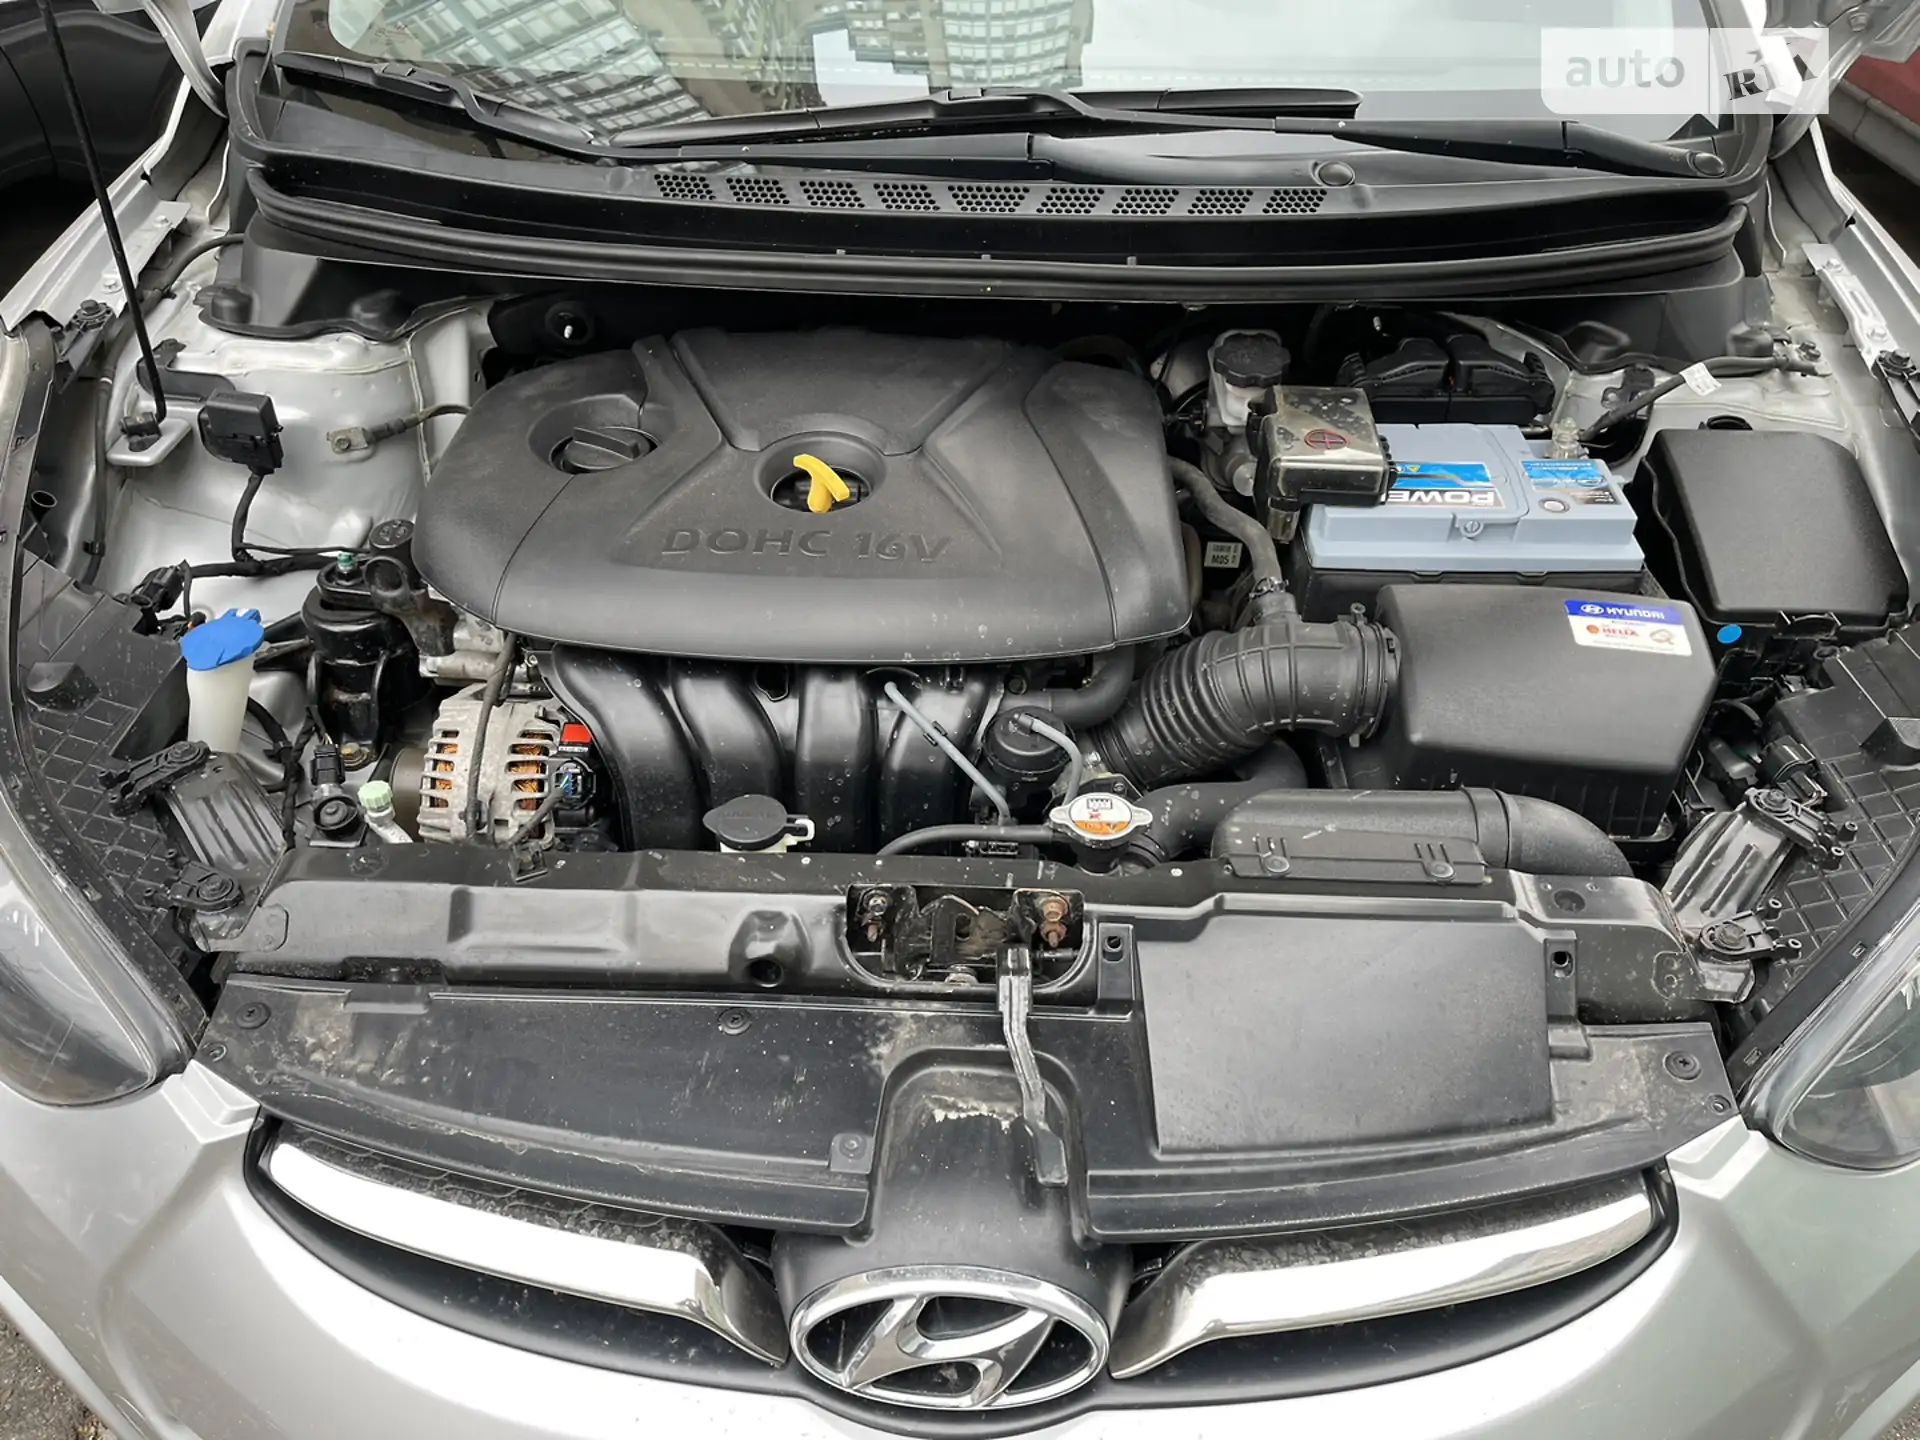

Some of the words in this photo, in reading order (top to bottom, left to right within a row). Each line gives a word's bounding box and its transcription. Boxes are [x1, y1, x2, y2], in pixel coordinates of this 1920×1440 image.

[660, 527, 834, 558] DOHC
[856, 531, 951, 563] 16V
[1606, 607, 1666, 619] HYUNDAI
